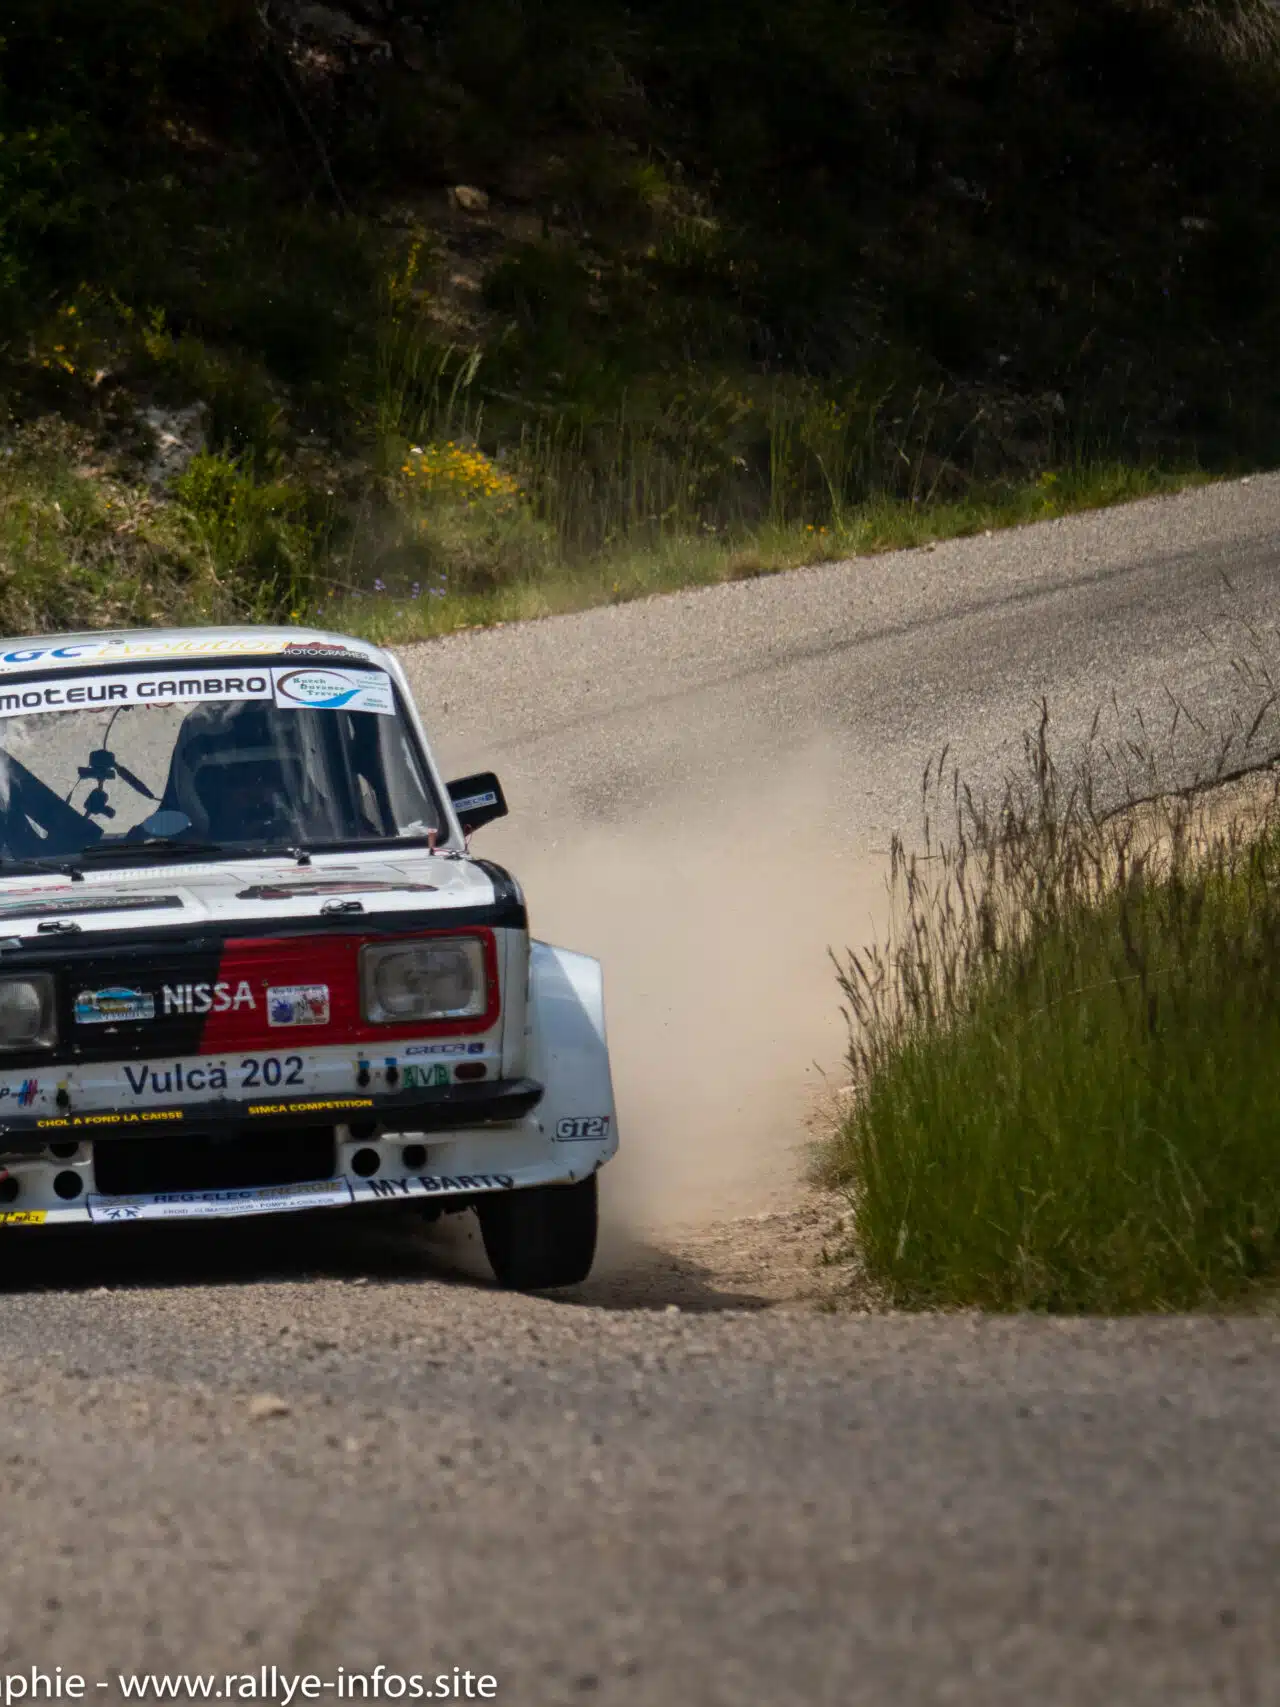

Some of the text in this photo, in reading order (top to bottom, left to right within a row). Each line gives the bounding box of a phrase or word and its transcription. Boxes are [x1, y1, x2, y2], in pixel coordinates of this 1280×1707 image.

[136, 676, 267, 698] GAMBRO
[162, 980, 256, 1014] NISSA
[124, 1056, 305, 1095] Vulca 202
[248, 1099, 373, 1115] SIMCA COMPETITION
[37, 1111, 184, 1128] CHOL A FOND LA CAISSE
[555, 1116, 610, 1139] GT2i
[368, 1177, 411, 1197] MY
